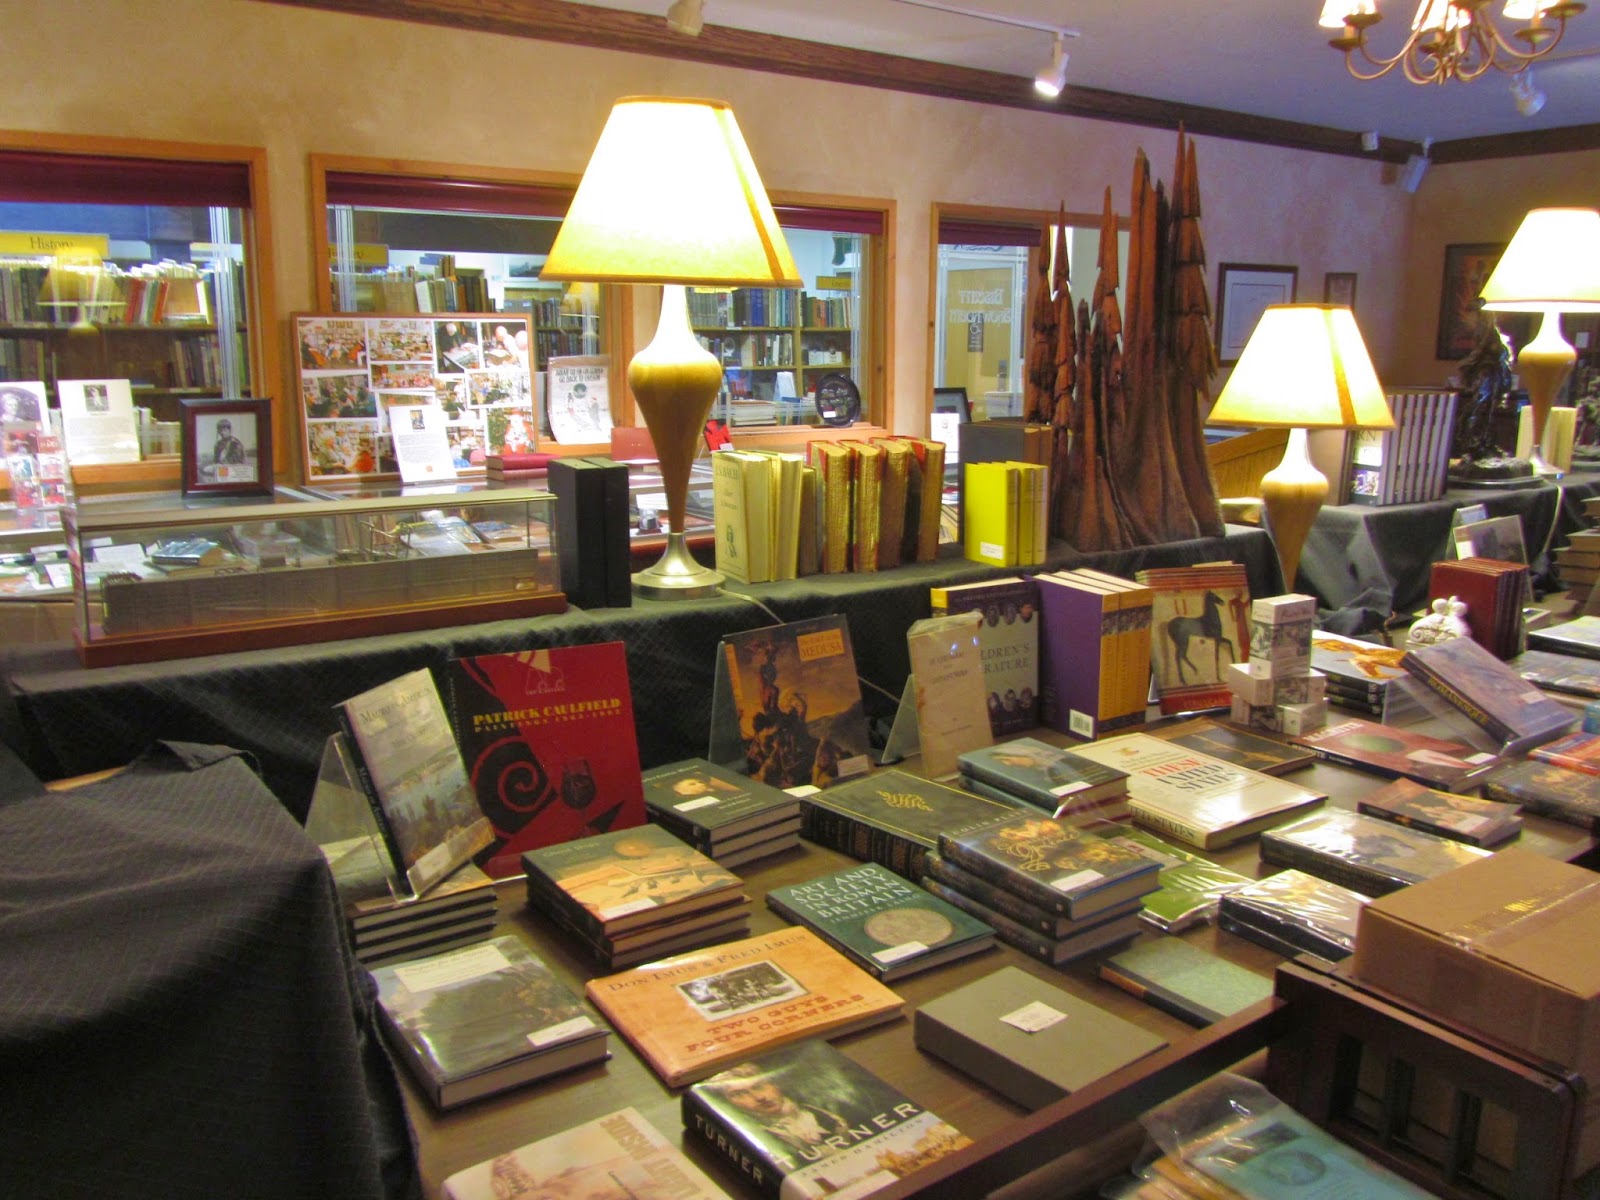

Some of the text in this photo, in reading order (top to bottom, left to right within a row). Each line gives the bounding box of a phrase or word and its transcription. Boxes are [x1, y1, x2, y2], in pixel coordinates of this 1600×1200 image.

[30, 236, 73, 251] History
[984, 657, 1029, 674] RATURE
[472, 697, 622, 726] PATRICK CAULFIELD
[474, 718, 549, 733] PAINTINGS
[1139, 757, 1205, 779] THESE
[1156, 763, 1224, 786] UNITED
[1176, 770, 1240, 792] STATES
[789, 867, 877, 897] ART AND
[795, 873, 887, 904] SOCIETY
[806, 879, 902, 911] IN ROMAN
[817, 885, 912, 918] BRITAIN
[700, 958, 713, 969] &
[685, 993, 865, 1053] FOUR CORNERS
[706, 994, 829, 1036] TWO GUYS
[693, 1113, 765, 1186] TURNER
[773, 1102, 920, 1170] TURNER
[801, 1150, 847, 1178] JAMES
